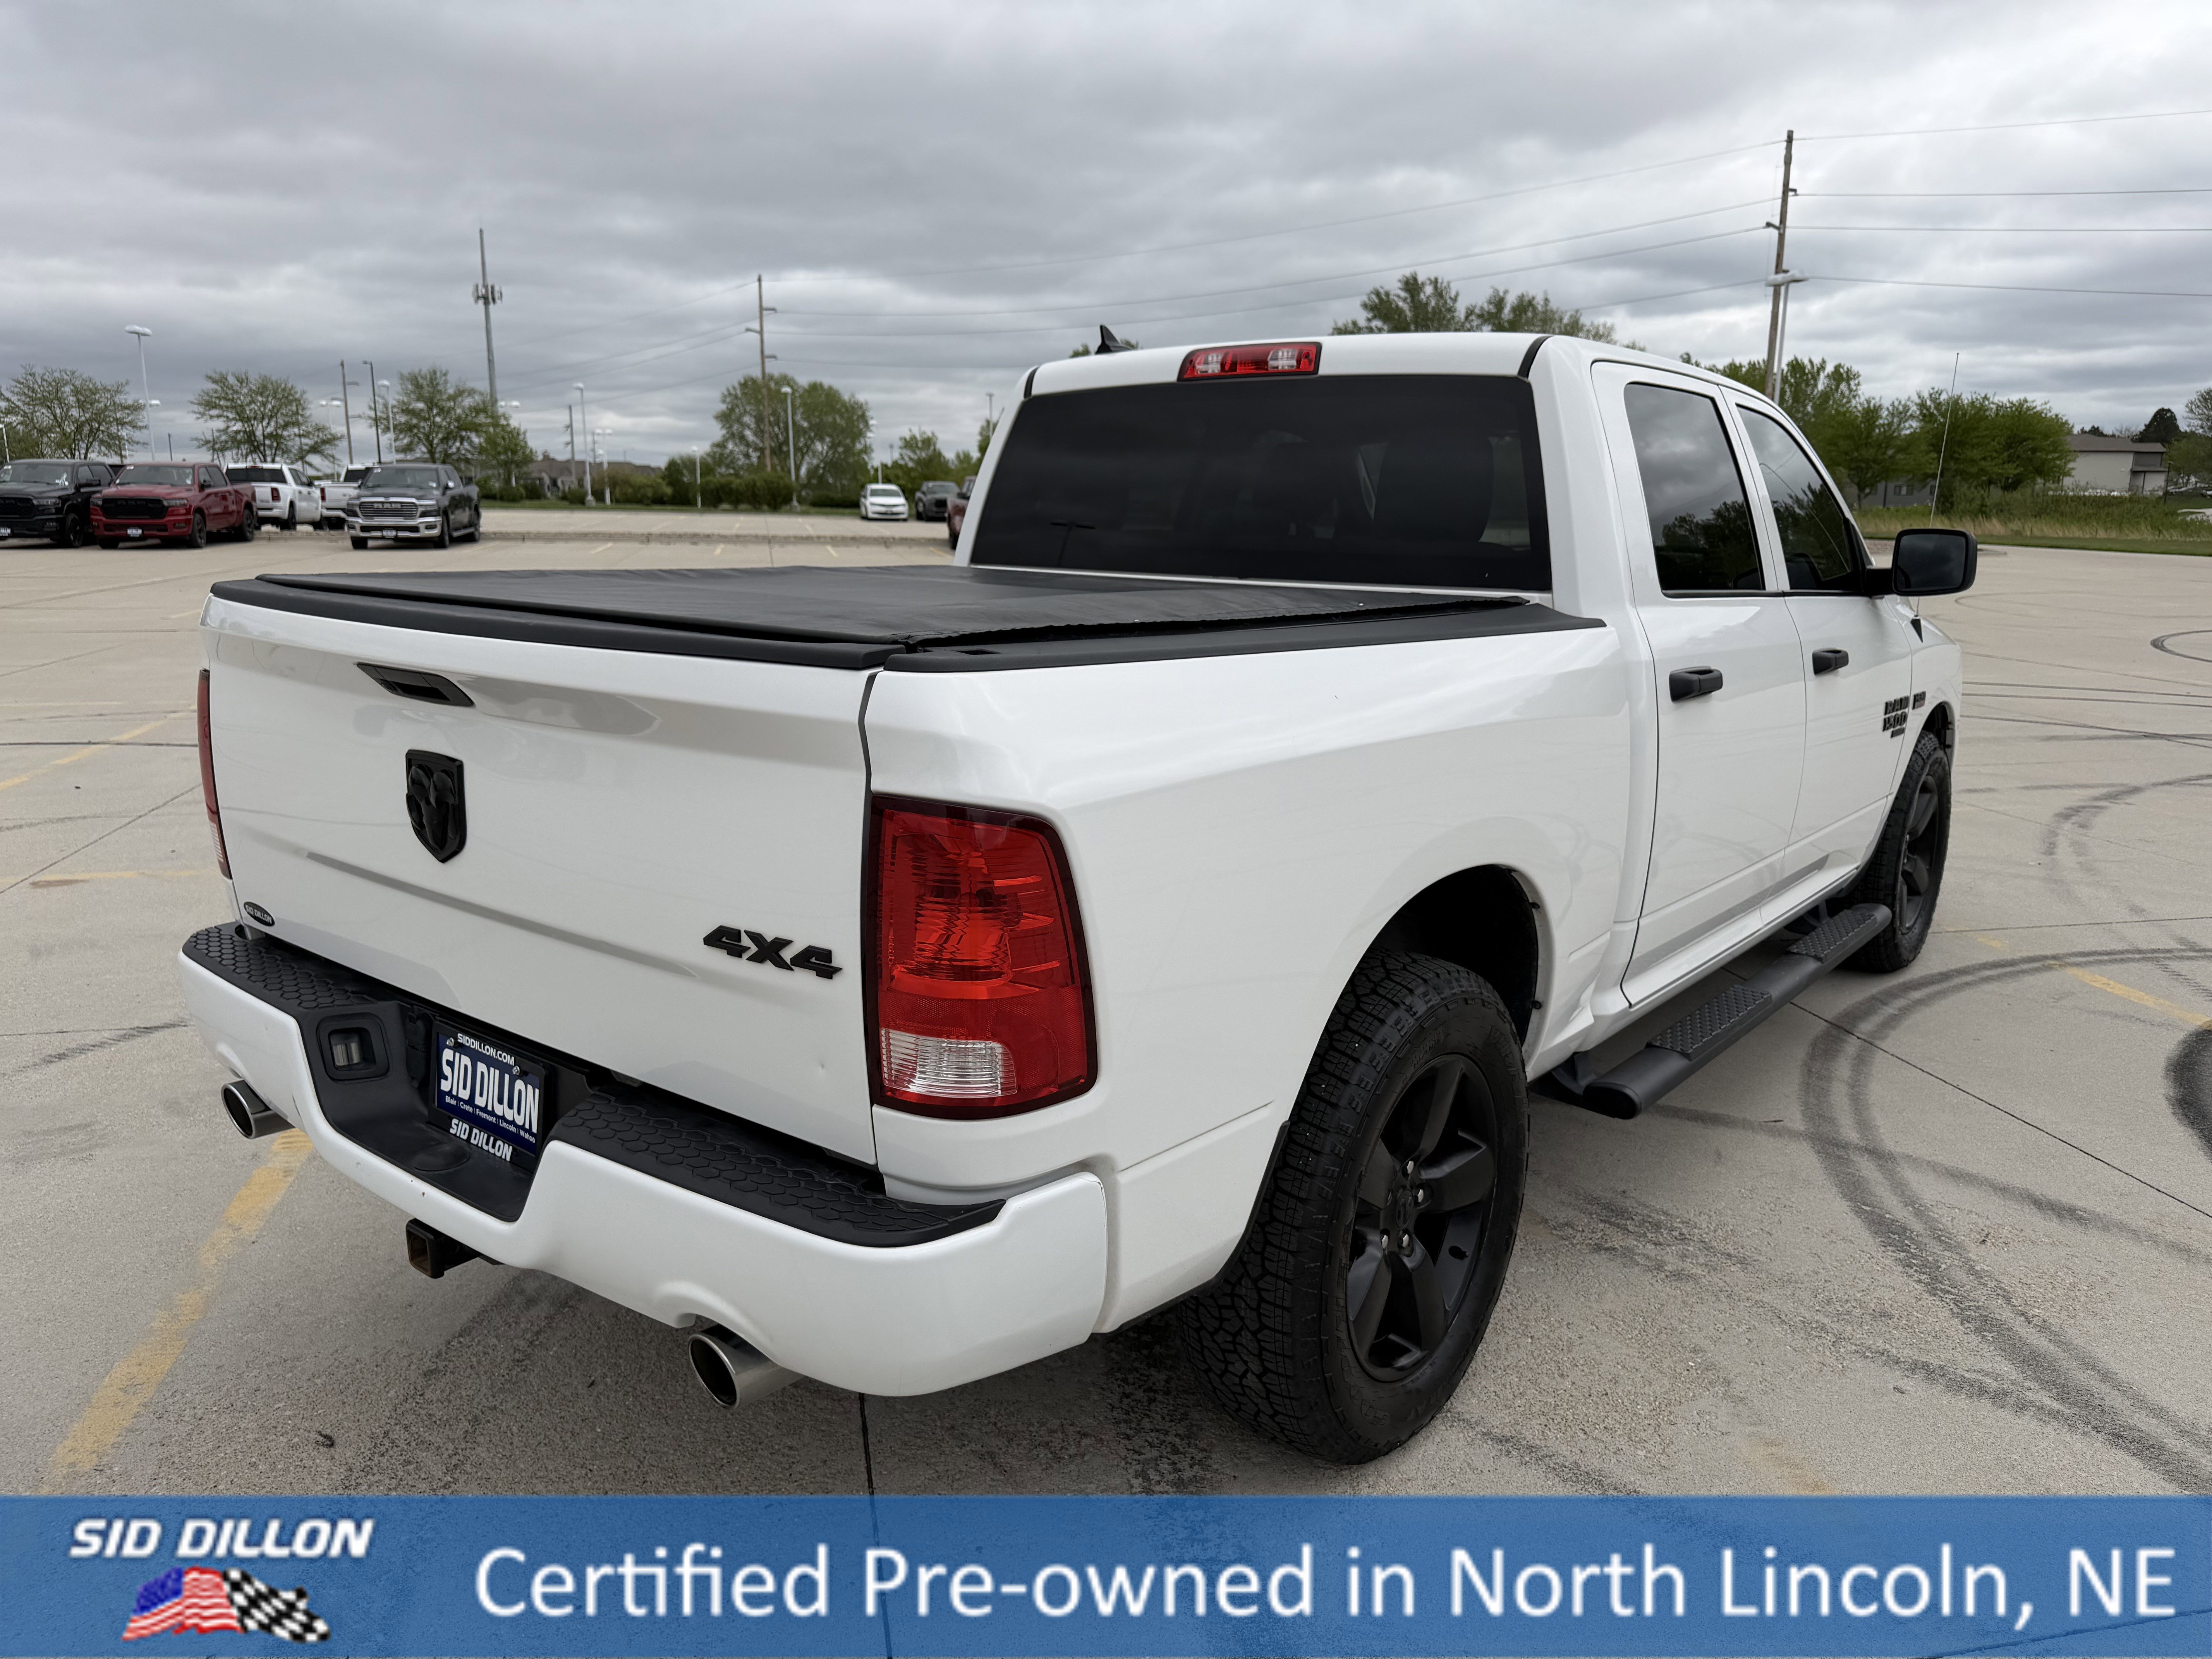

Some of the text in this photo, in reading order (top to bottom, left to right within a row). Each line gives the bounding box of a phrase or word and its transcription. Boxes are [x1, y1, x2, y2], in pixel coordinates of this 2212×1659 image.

[245, 905, 272, 924] SID DILLON
[703, 925, 843, 979] 4X4
[458, 1033, 514, 1066] SIDDILLON.COM
[441, 1048, 539, 1134] SID DILLON
[445, 1095, 536, 1143] Blair Crete Fremont Lincoln Wahoo
[450, 1118, 513, 1162] SID DILLON
